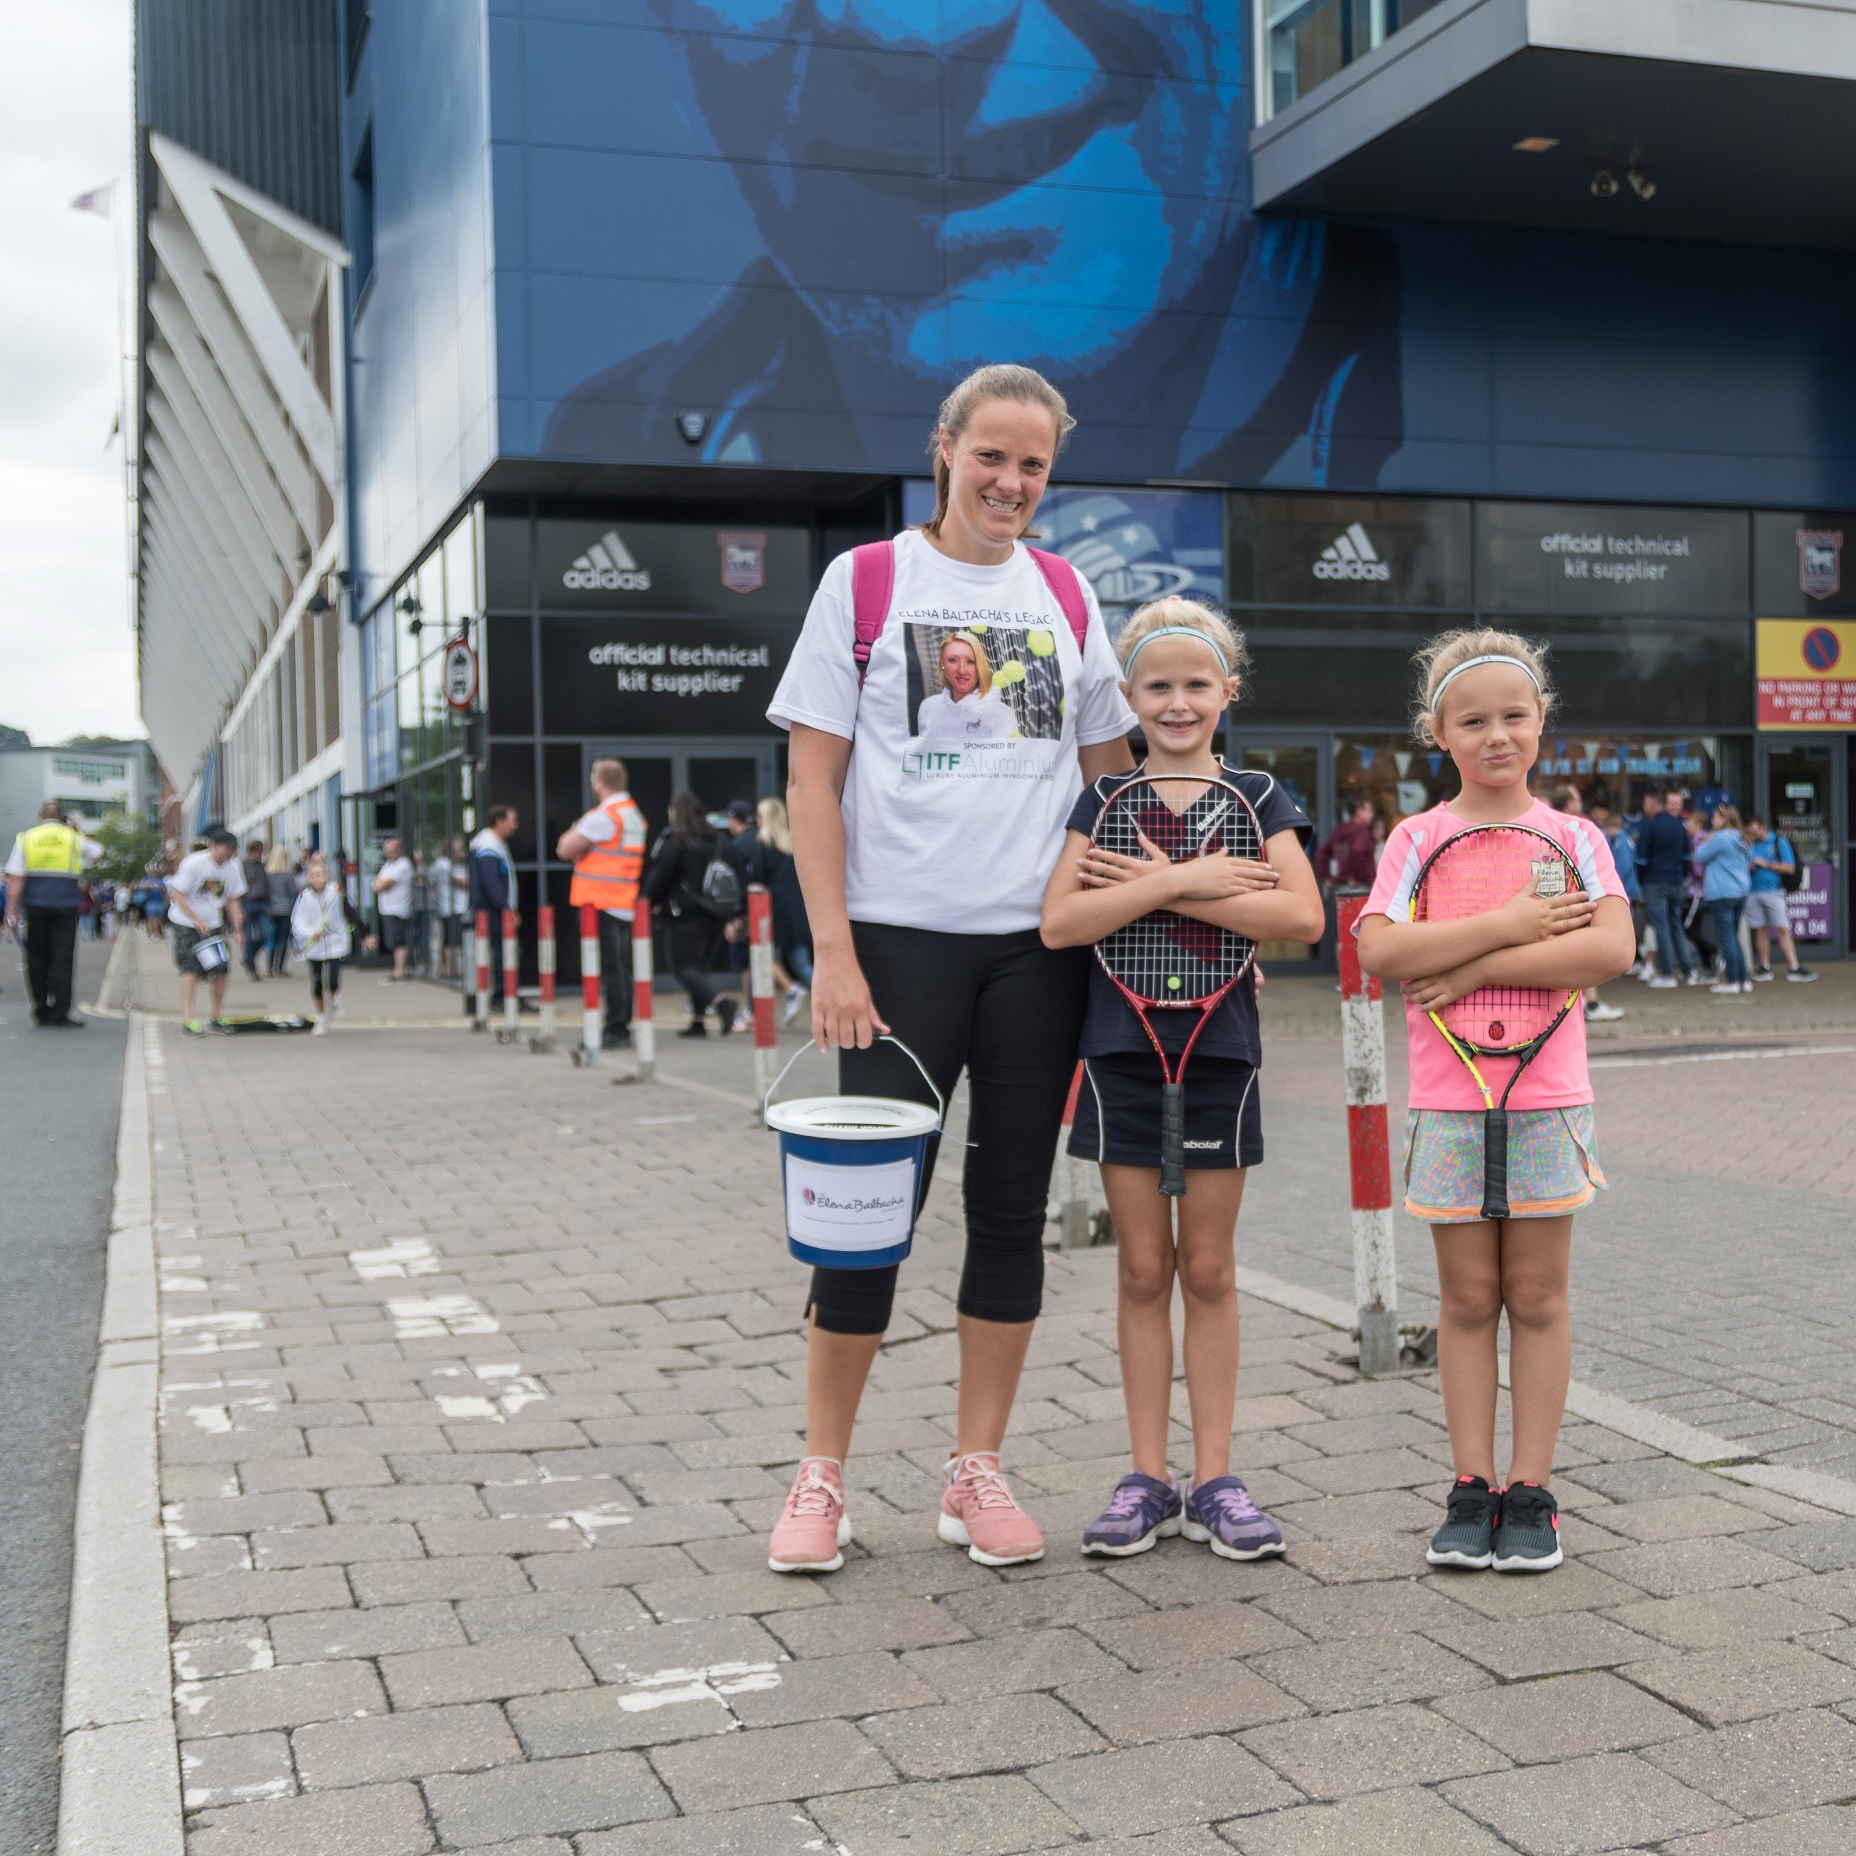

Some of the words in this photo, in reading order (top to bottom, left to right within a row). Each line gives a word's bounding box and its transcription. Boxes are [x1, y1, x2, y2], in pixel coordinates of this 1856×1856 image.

[1540, 532, 1603, 554] official
[1607, 533, 1690, 557] technical
[1312, 559, 1391, 581] adidas
[1564, 556, 1588, 579] kit
[1592, 557, 1669, 584] supplier
[562, 568, 651, 591] adidas
[898, 609, 939, 619] ELENA
[943, 608, 1011, 623] BALTACHA'S
[588, 642, 666, 665] official
[669, 643, 770, 667] technical
[617, 668, 649, 692] kit
[651, 669, 744, 697] supplier
[1758, 681, 1776, 695] NO
[1777, 681, 1822, 695] PARKING
[1823, 681, 1840, 695] OR
[1772, 695, 1786, 709] IN
[1786, 695, 1821, 709] FRONT
[1822, 695, 1839, 709] OF
[1790, 709, 1803, 722] AT
[1805, 709, 1827, 722] ANY
[1829, 709, 1853, 722] TIME
[963, 742, 1005, 750] SPONSORED
[1008, 742, 1016, 750] BY
[927, 752, 960, 770] ITF
[1169, 1000, 1191, 1008] YONEX
[1182, 1140, 1223, 1149] abolat
[816, 1197, 853, 1210] Elena
[852, 1196, 905, 1213] Baltacha
